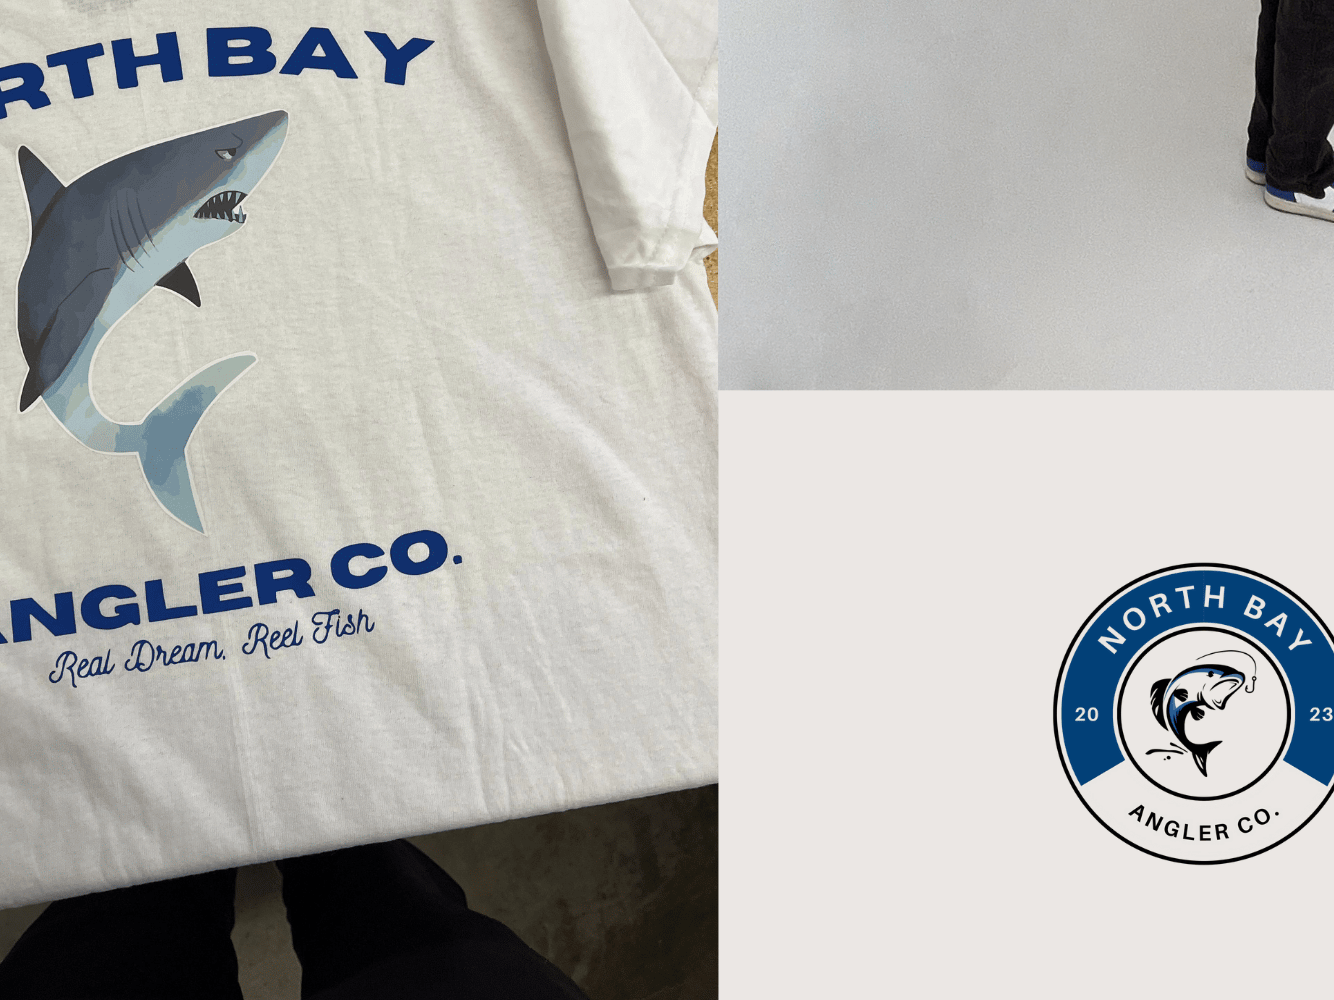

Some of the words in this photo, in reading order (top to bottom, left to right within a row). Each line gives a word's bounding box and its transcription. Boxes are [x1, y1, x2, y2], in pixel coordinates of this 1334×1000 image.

[205, 25, 436, 87] BAY
[329, 529, 463, 590] CO.
[48, 650, 116, 689] Real
[241, 620, 304, 660] Reel
[311, 608, 376, 645] Fish
